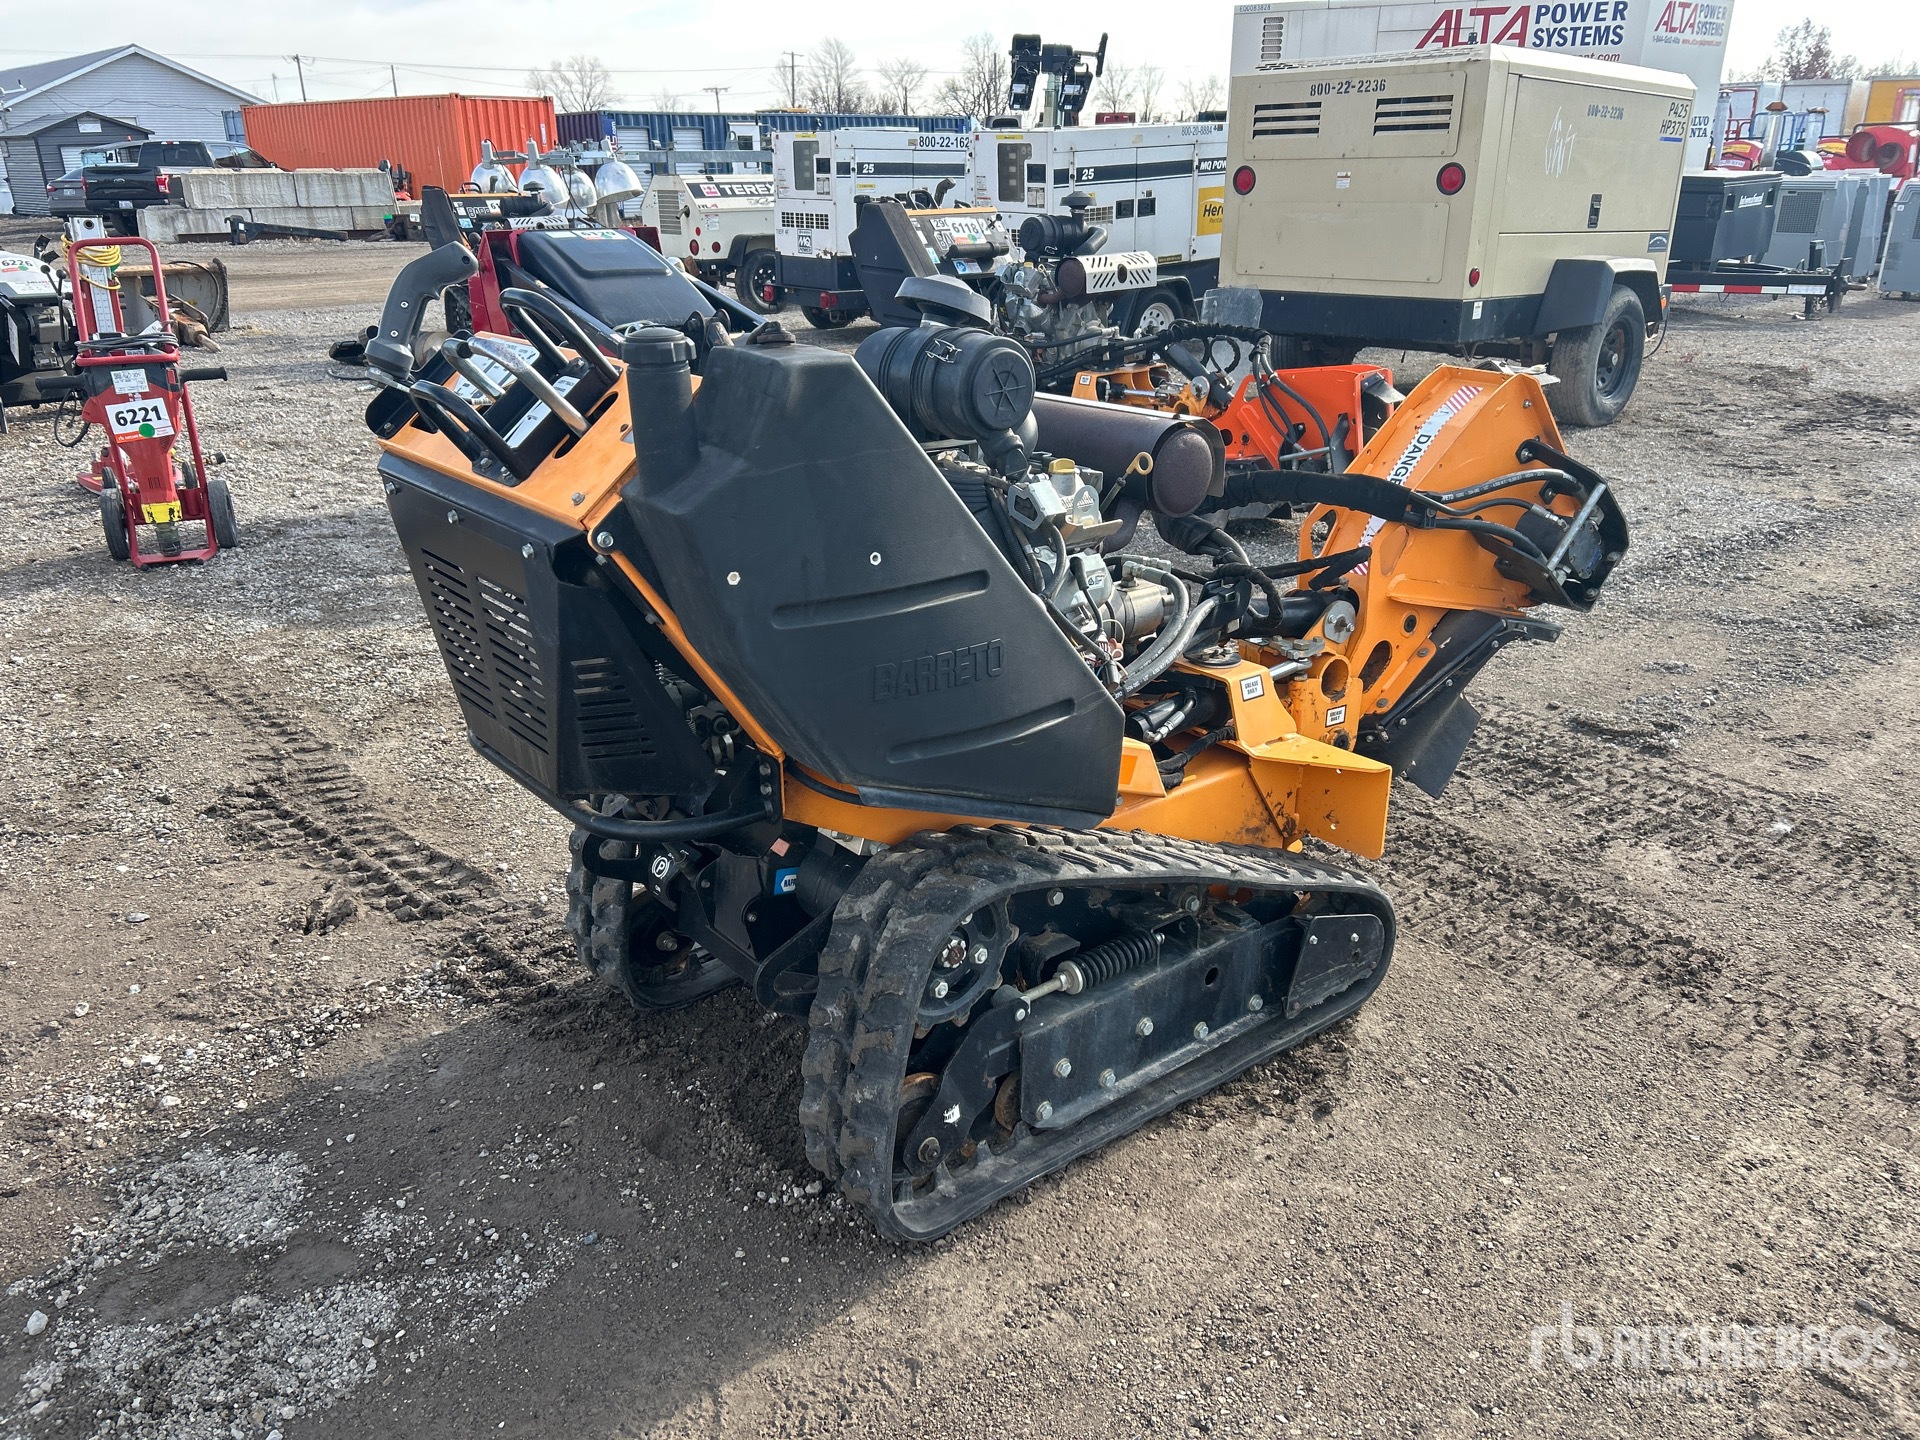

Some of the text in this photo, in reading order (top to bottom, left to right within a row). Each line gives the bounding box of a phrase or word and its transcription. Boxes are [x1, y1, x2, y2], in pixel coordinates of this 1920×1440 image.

[1535, 1, 1629, 24] POWER
[1654, 0, 1699, 35] ALTA
[1698, 4, 1727, 20] POWER
[1415, 5, 1531, 49] ALTA
[1695, 20, 1725, 37] SYSTEMS
[1532, 25, 1624, 48] SYSTEMS
[1310, 79, 1386, 97] 800-22-2236
[1587, 104, 1624, 120] 800-22-2236
[1668, 102, 1689, 118] P425
[1659, 119, 1686, 136] HP375
[1691, 116, 1710, 126] LVO
[1689, 128, 1708, 138] NTA
[918, 136, 970, 148] 800-22-162
[862, 163, 875, 173] 25
[1199, 160, 1226, 171] MQ POW
[1081, 168, 1095, 180] 25
[1203, 203, 1223, 217] Her
[952, 222, 979, 234] 6118
[115, 405, 162, 426] 6221
[1389, 433, 1432, 485] DANGE
[872, 638, 1004, 702] BARRETO
[1244, 681, 1259, 690] GREASE
[1246, 687, 1258, 695] DAILY
